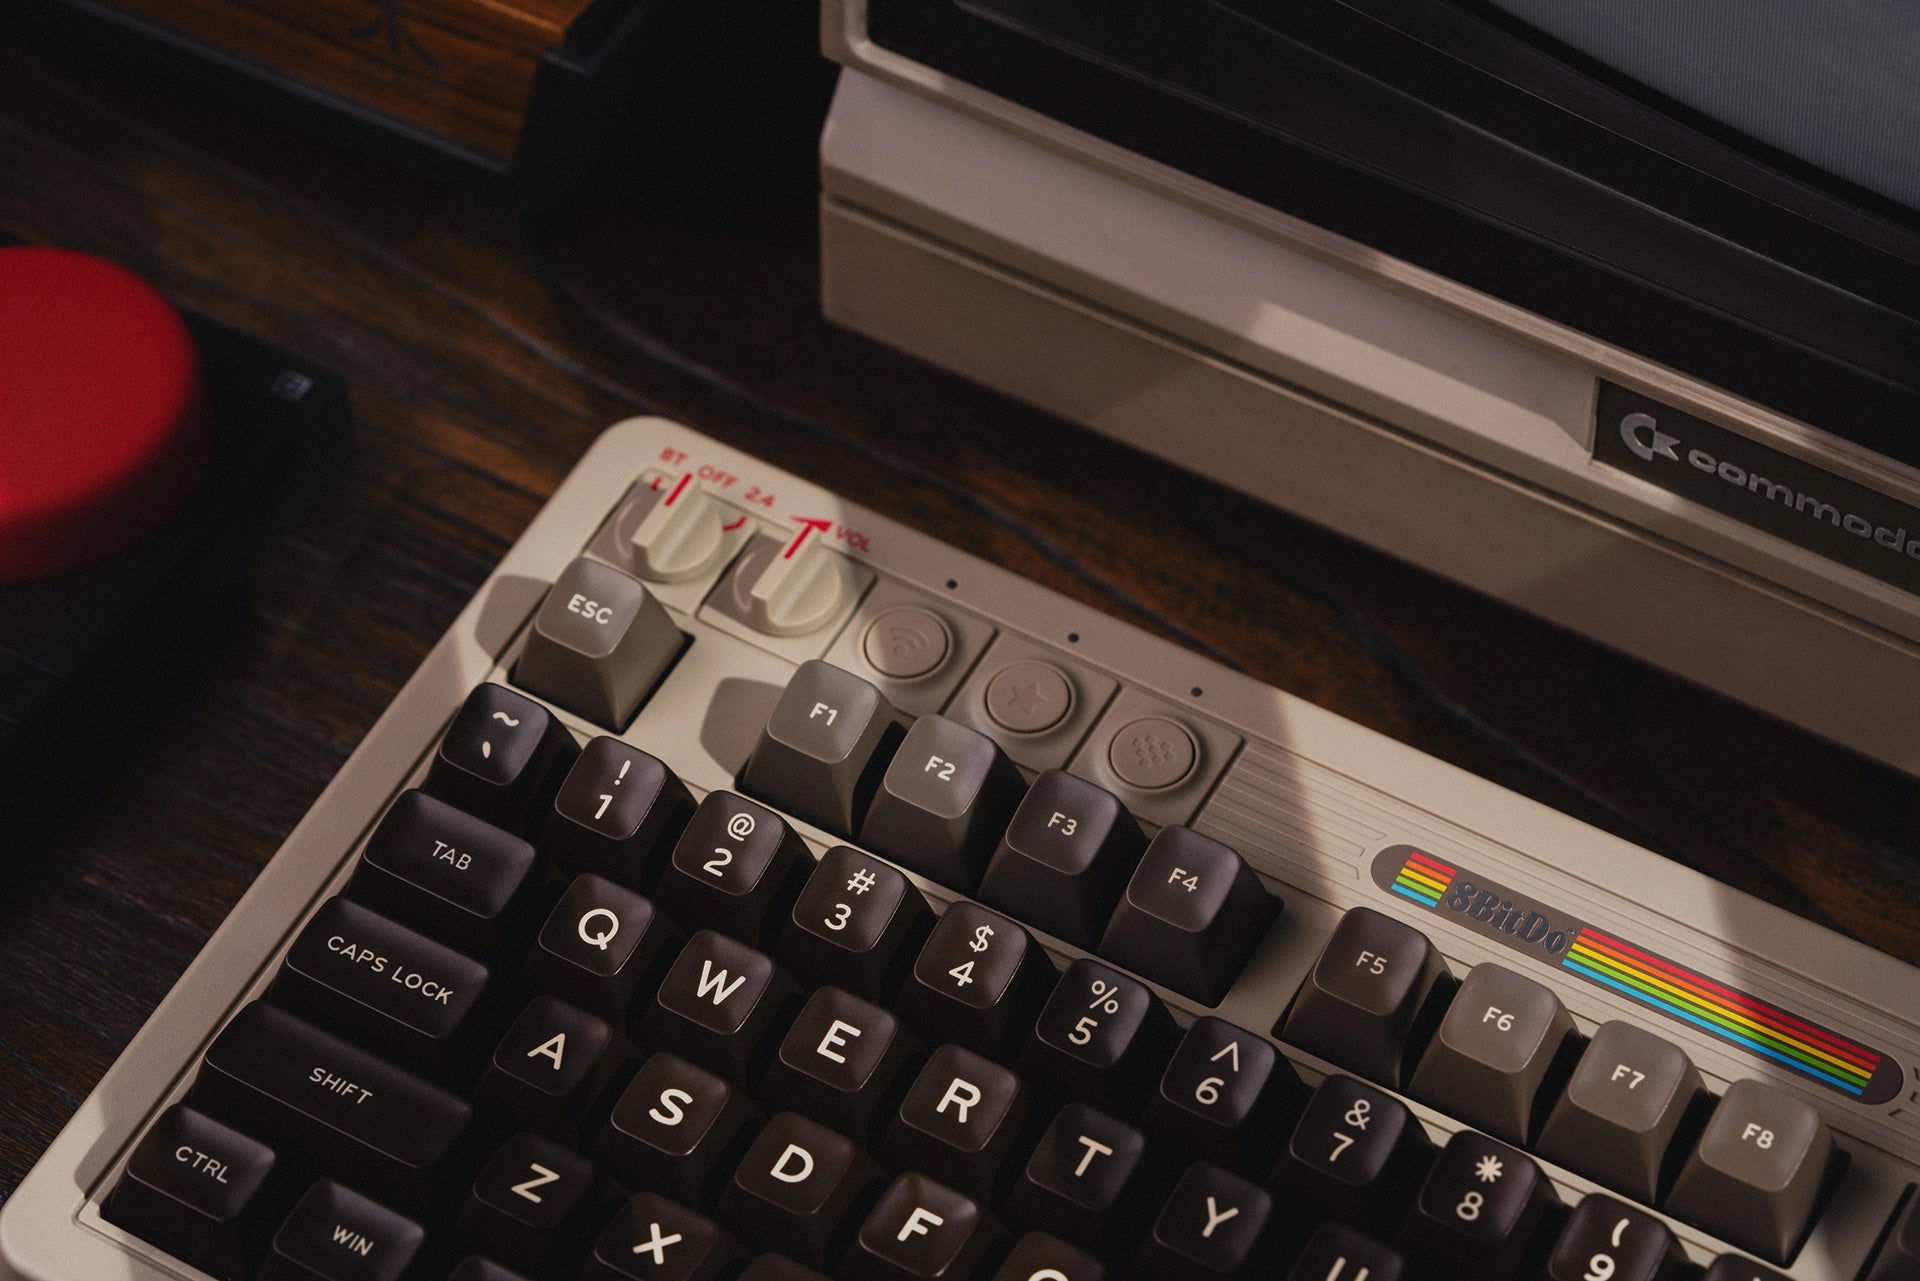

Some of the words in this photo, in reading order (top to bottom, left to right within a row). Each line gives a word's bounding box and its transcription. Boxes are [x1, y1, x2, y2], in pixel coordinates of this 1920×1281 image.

[659, 447, 688, 465] BT
[697, 465, 739, 488] OFF
[835, 525, 871, 552] VOL
[567, 593, 614, 625] ESC
[809, 702, 838, 726] F1
[614, 760, 631, 786] !
[924, 755, 956, 782] F2
[594, 794, 613, 820] 1
[727, 812, 755, 842] @
[1047, 811, 1077, 836] F3
[432, 840, 472, 870] TAB
[702, 847, 733, 877] 2
[846, 868, 876, 895] #
[1167, 867, 1198, 893] F4
[578, 908, 619, 951] Q
[824, 903, 852, 931] 3
[969, 924, 995, 953] $
[327, 936, 388, 973] CAPS
[391, 966, 454, 1005] LOCK
[948, 960, 975, 987] 4
[1356, 950, 1387, 975] F5
[696, 959, 747, 1006] W
[1089, 980, 1119, 1014] %
[1067, 1016, 1098, 1045] 5
[1482, 1006, 1515, 1032] F6
[527, 1033, 566, 1071] A
[816, 1019, 862, 1064] E
[309, 1067, 373, 1104] SHIFT
[1195, 1077, 1225, 1105] 6
[1611, 1064, 1646, 1089] F7
[648, 1088, 693, 1126] S
[936, 1077, 981, 1123] R
[1344, 1099, 1371, 1130] &
[1329, 1132, 1354, 1162] 7
[1741, 1122, 1774, 1149] F8
[175, 1146, 228, 1184] CTRL
[770, 1143, 814, 1183] D
[1074, 1135, 1113, 1177] T
[511, 1163, 560, 1204] Z
[1202, 1196, 1239, 1238] Y
[1456, 1191, 1484, 1221] 8
[897, 1207, 944, 1242] F
[332, 1225, 374, 1256] WIN
[633, 1223, 682, 1265] X
[1583, 1253, 1615, 1281] 9
